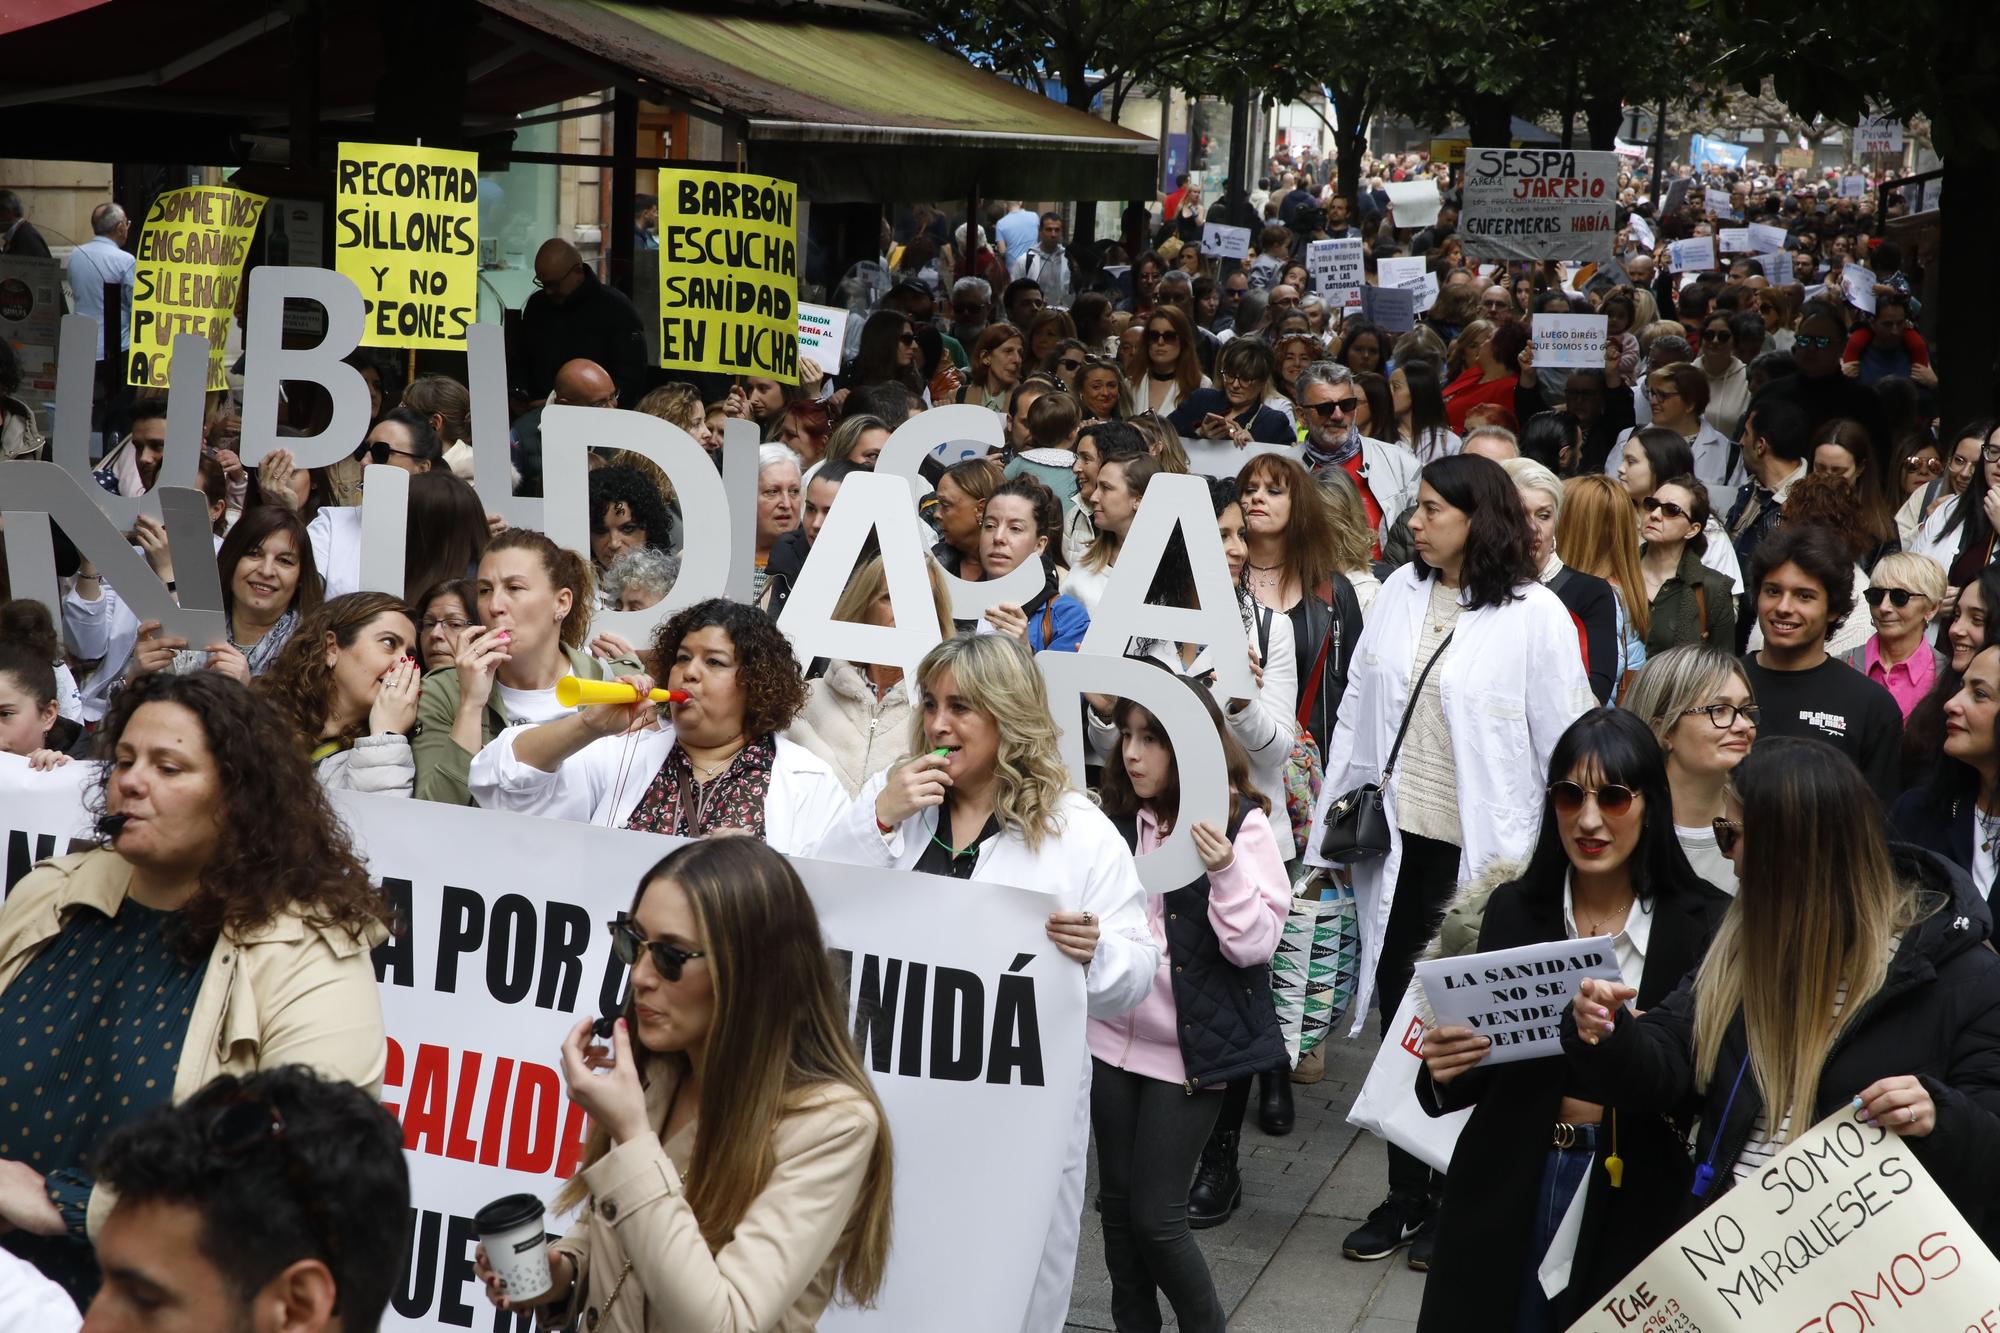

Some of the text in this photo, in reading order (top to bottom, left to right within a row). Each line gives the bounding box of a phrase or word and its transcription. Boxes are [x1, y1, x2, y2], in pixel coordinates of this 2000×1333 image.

[339, 160, 478, 204] RECORTAD
[1476, 150, 1576, 178] SESPA
[678, 179, 793, 227] BARBÓN
[1571, 210, 1610, 233] HABÍA
[1466, 216, 1561, 235] ENFERMERAS
[667, 226, 796, 278] ESCUCHA
[370, 266, 448, 296] Y NO
[662, 317, 797, 377] EN LUCHA
[822, 330, 833, 338] AL
[1533, 342, 1551, 351] QUE
[1551, 342, 1582, 351] SOMOS
[1584, 343, 1589, 351] 5
[1540, 328, 1598, 339] LUEGO DIRÉIS
[434, 884, 592, 1014] POR
[827, 946, 1046, 1088] NIDÁ
[1443, 952, 1603, 990] LA SANIDAD
[1491, 981, 1567, 1004] NO SE
[1680, 1106, 1887, 1281] NO SOMOS
[1716, 1156, 1914, 1320] MARQUESES
[1602, 1280, 1659, 1329] TCAE
